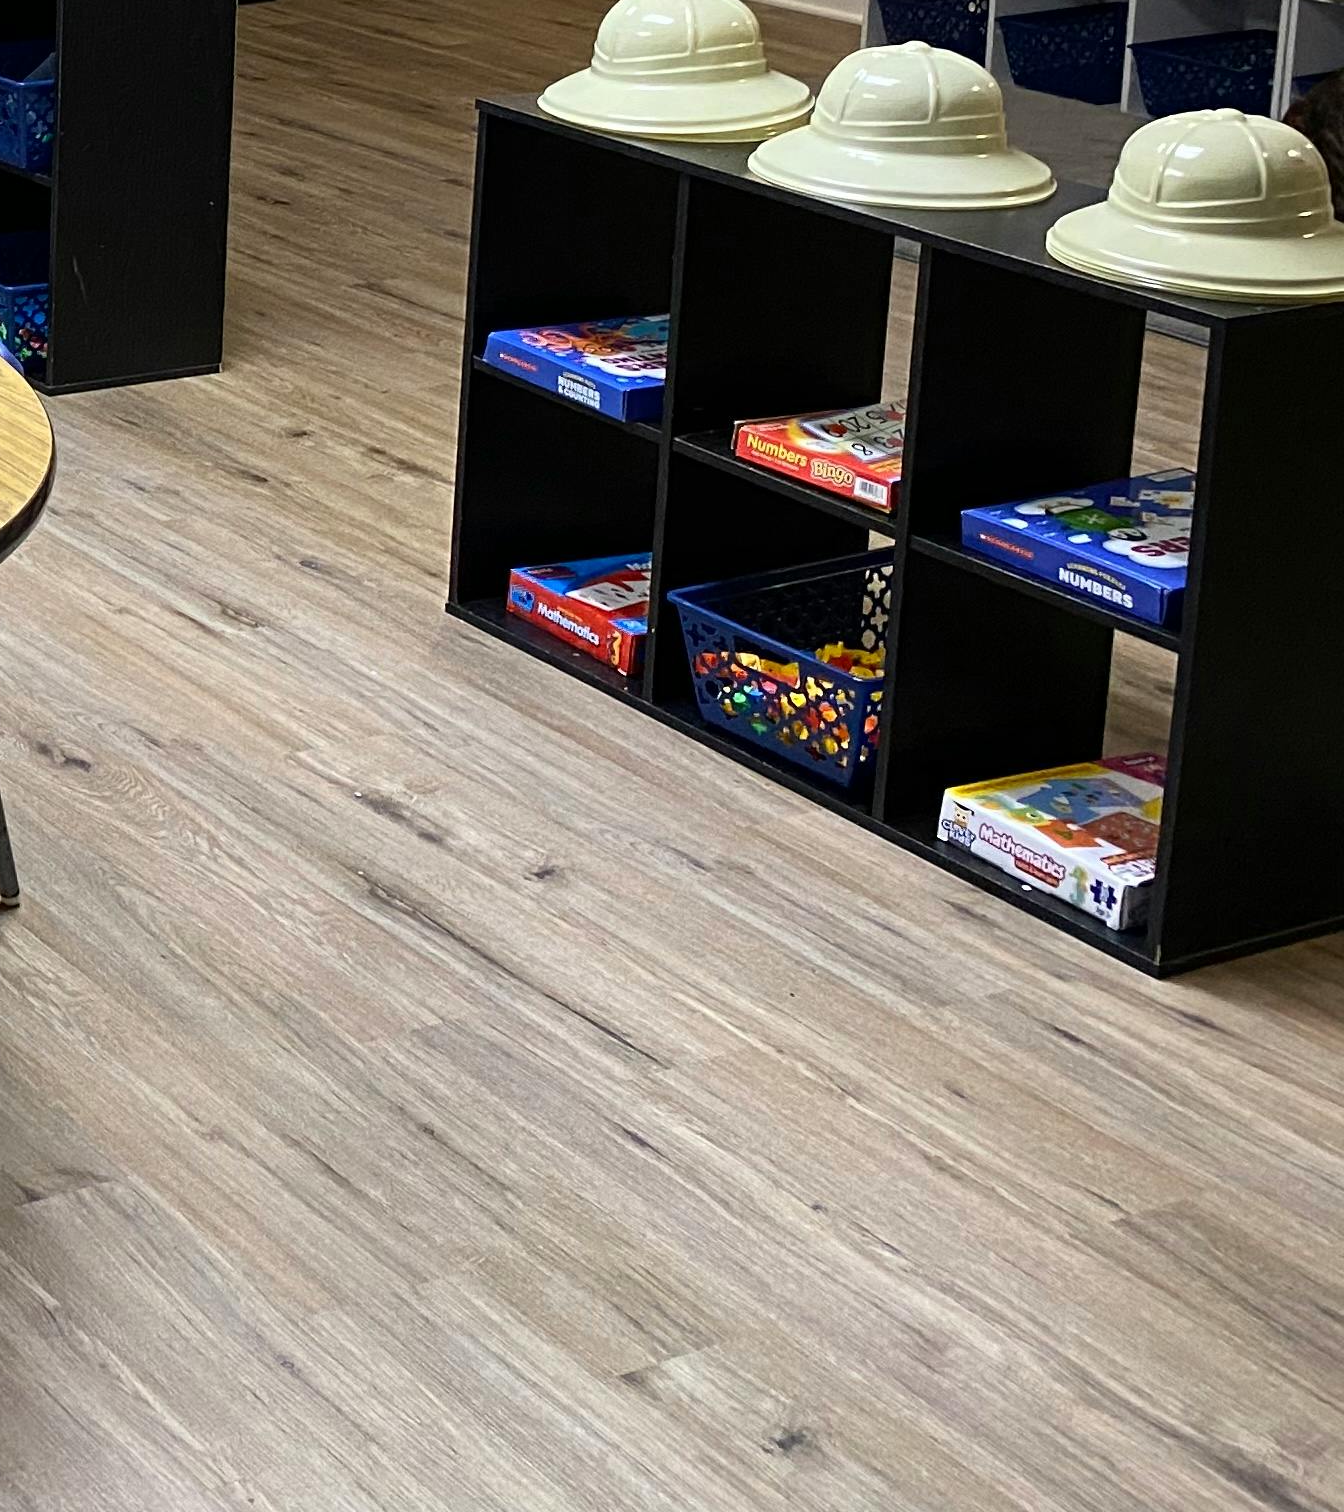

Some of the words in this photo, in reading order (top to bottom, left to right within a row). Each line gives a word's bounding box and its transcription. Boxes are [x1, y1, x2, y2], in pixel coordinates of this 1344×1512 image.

[557, 374, 601, 400] NUMBERS
[746, 432, 808, 468] Numbers
[812, 460, 855, 486] Bingo
[1058, 566, 1134, 610] NUMBERS
[537, 601, 600, 647] Mathematics
[979, 821, 1066, 882] Mathematics
